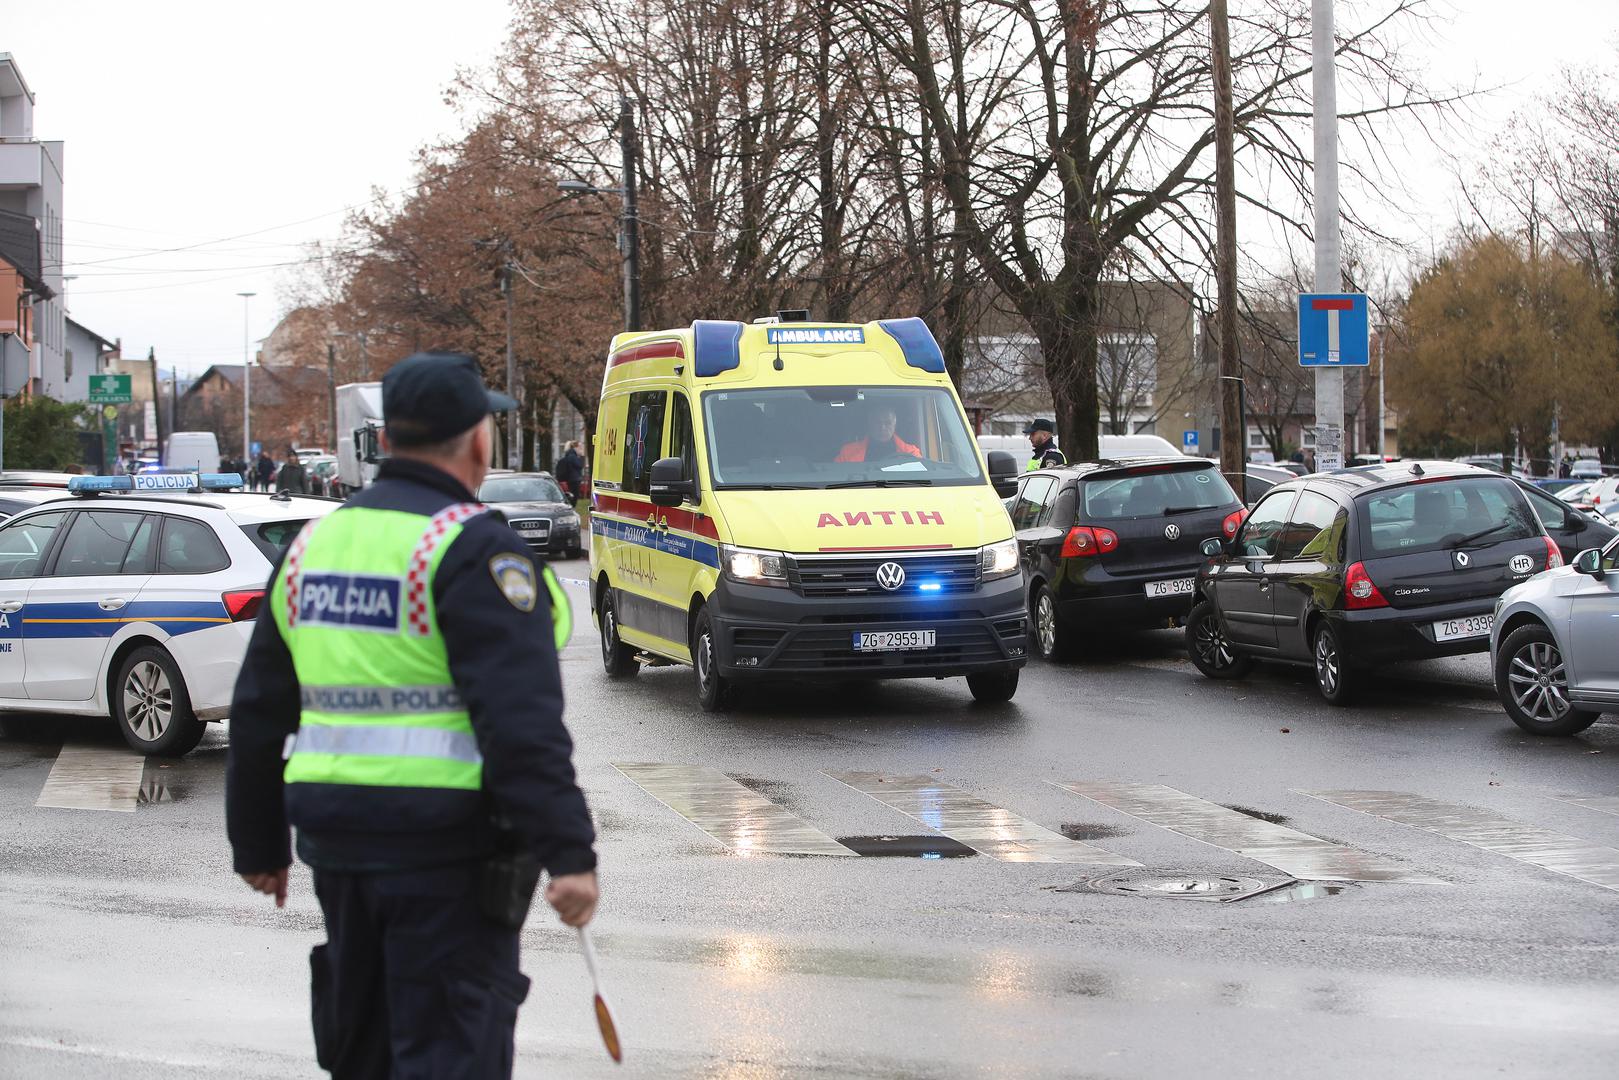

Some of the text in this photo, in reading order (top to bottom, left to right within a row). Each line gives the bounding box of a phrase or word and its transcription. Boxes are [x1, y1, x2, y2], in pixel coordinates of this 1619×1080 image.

[771, 329, 861, 343] AMBULANCE
[1187, 433, 1194, 444] P
[137, 476, 194, 489] POLICIJA
[1513, 559, 1530, 569] HR
[1153, 583, 1167, 595] ZG
[1442, 621, 1459, 635] ZG
[862, 633, 878, 647] ZG
